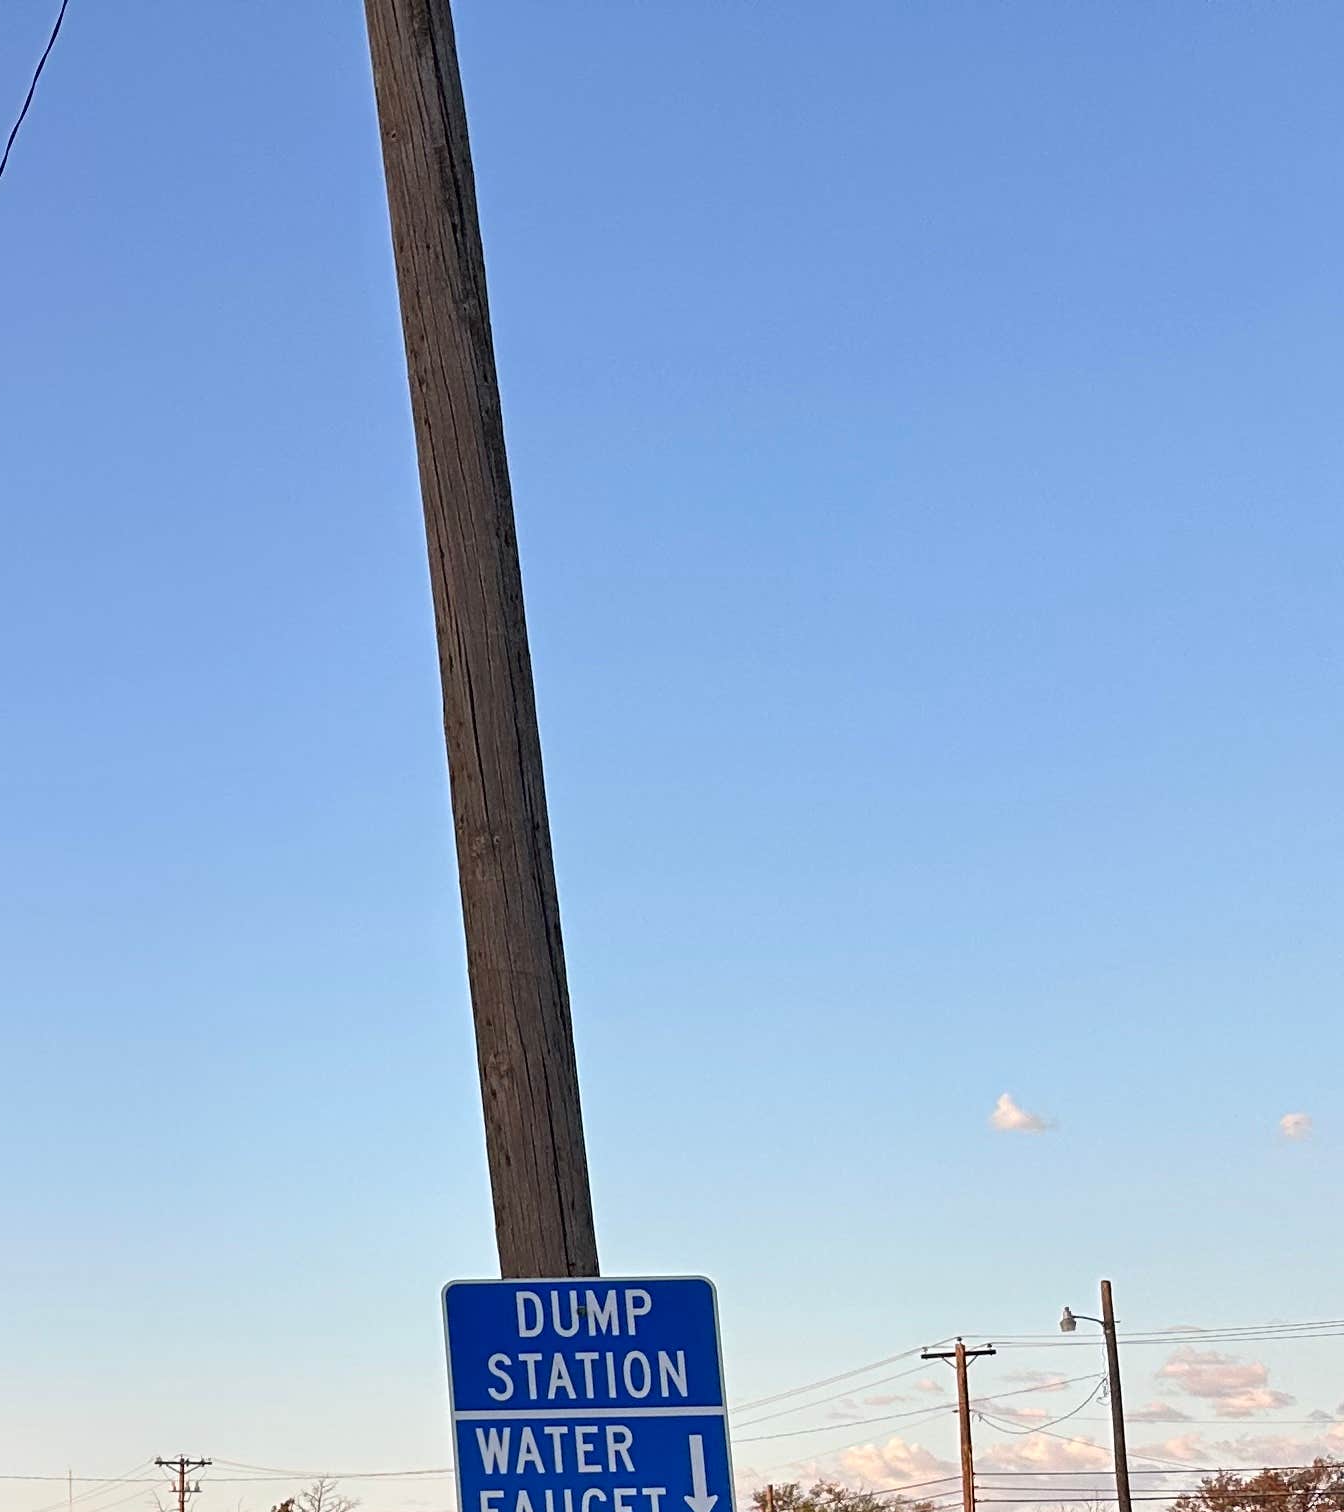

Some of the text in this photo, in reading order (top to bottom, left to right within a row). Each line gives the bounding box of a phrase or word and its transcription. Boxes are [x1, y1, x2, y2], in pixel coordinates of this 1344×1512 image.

[515, 1288, 652, 1338] DUMP
[487, 1350, 689, 1402] STATION
[475, 1424, 636, 1476] WATER
